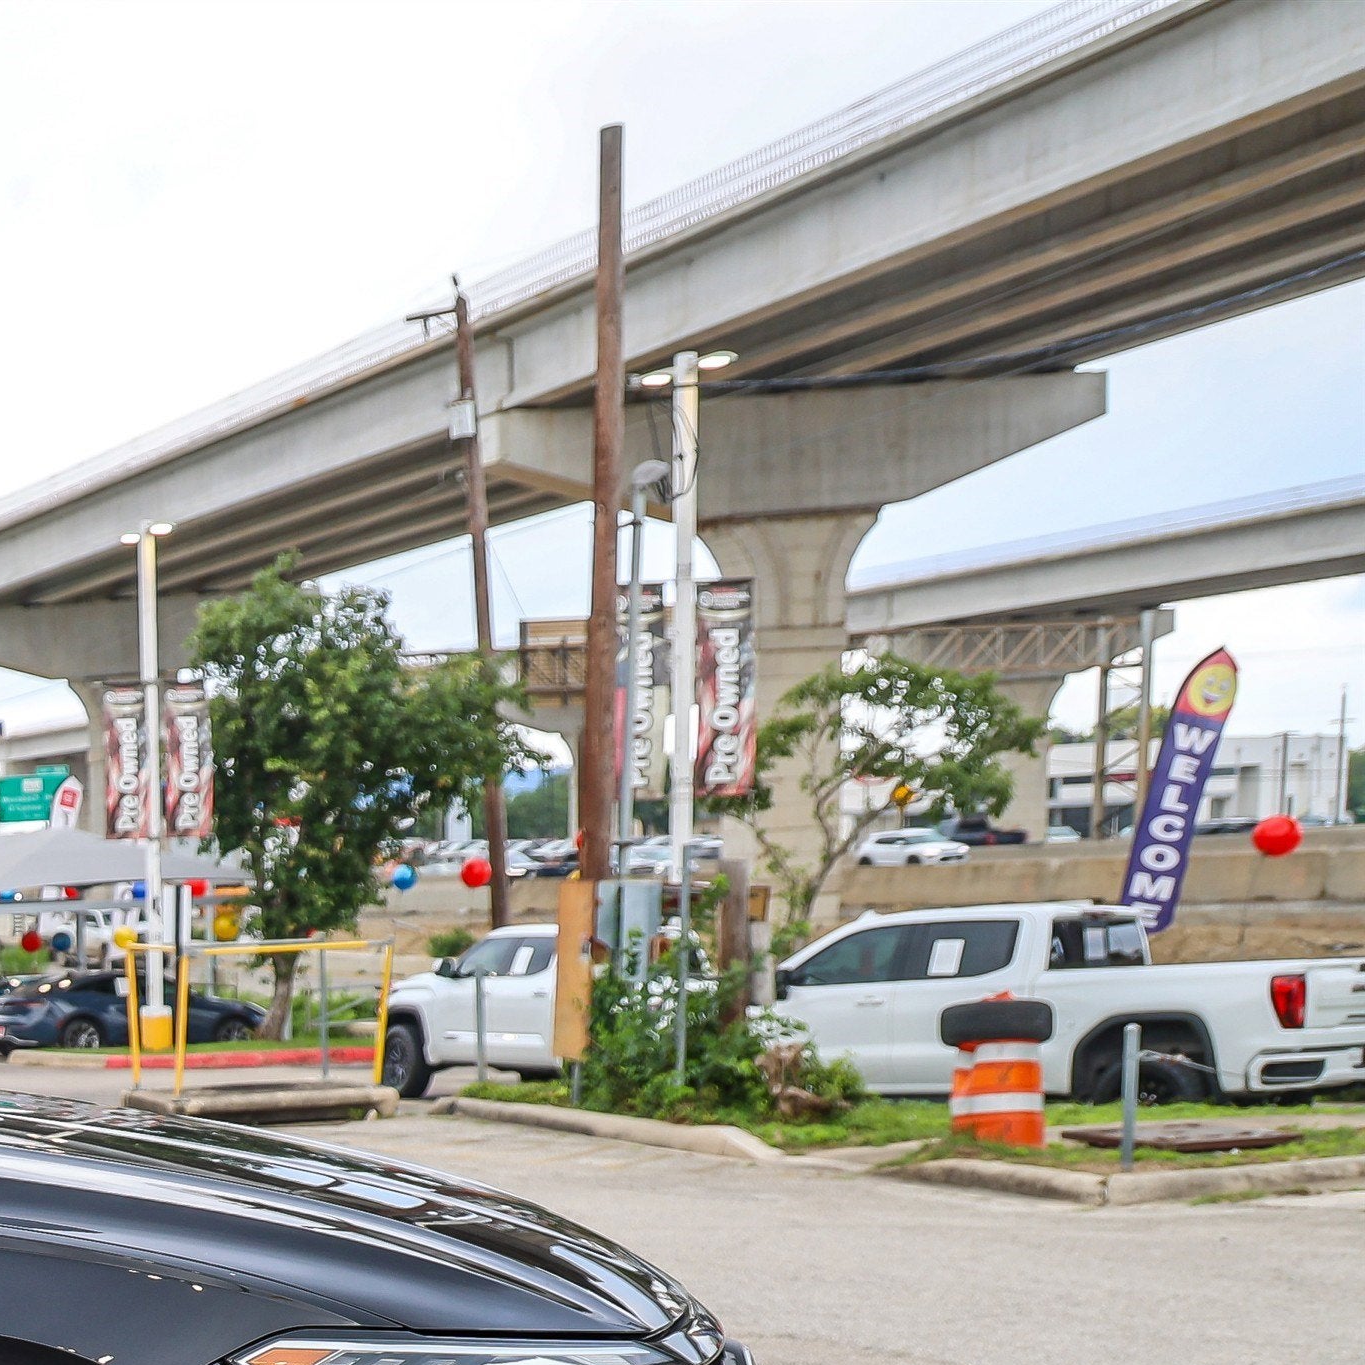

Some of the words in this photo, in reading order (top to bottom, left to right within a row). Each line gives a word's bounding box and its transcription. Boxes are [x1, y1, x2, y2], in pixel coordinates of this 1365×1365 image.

[707, 628, 741, 733] Owned
[113, 717, 139, 793] Owned
[173, 715, 199, 791] Owned
[704, 734, 740, 785] Pre
[115, 793, 139, 832] Pre
[175, 792, 199, 831] Pre
[1128, 722, 1218, 929] WELCOME
